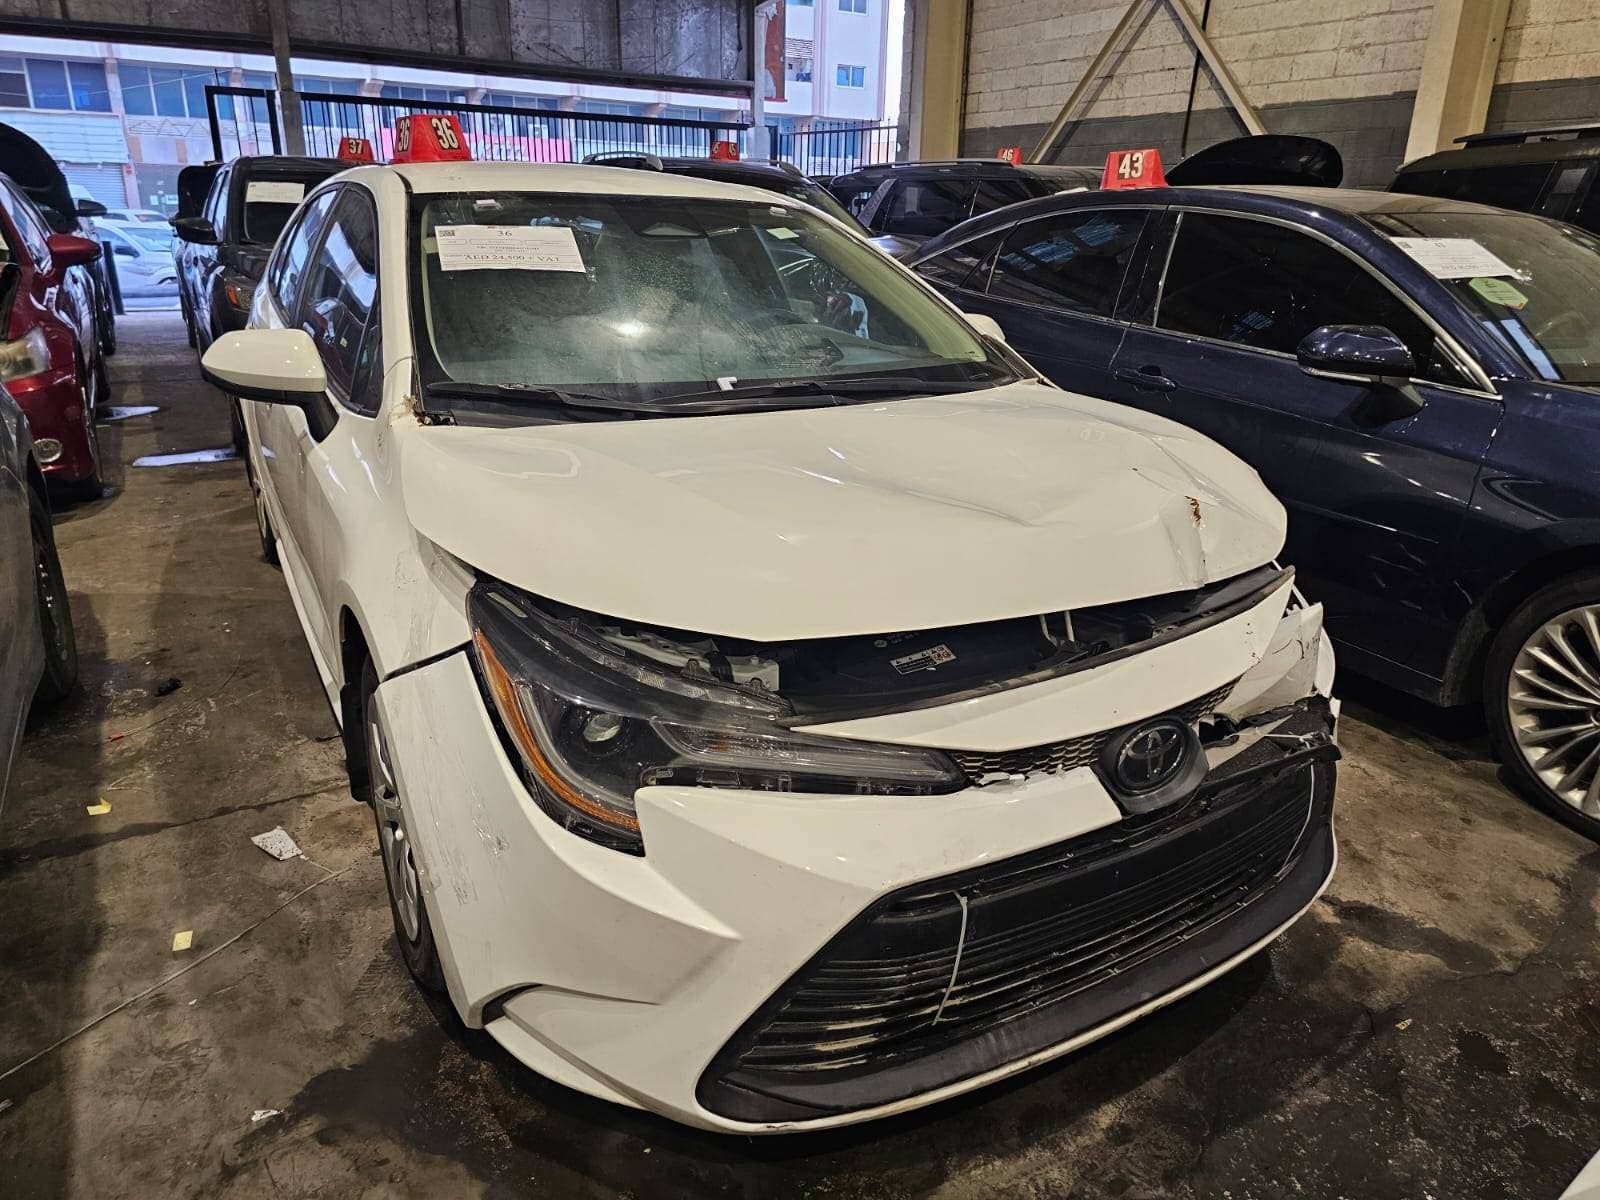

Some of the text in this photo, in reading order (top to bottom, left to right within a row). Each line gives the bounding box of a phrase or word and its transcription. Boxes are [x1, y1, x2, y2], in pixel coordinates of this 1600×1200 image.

[349, 139, 363, 154] 37
[398, 118, 411, 152] 36
[431, 117, 459, 149] 36
[1118, 152, 1143, 179] 43
